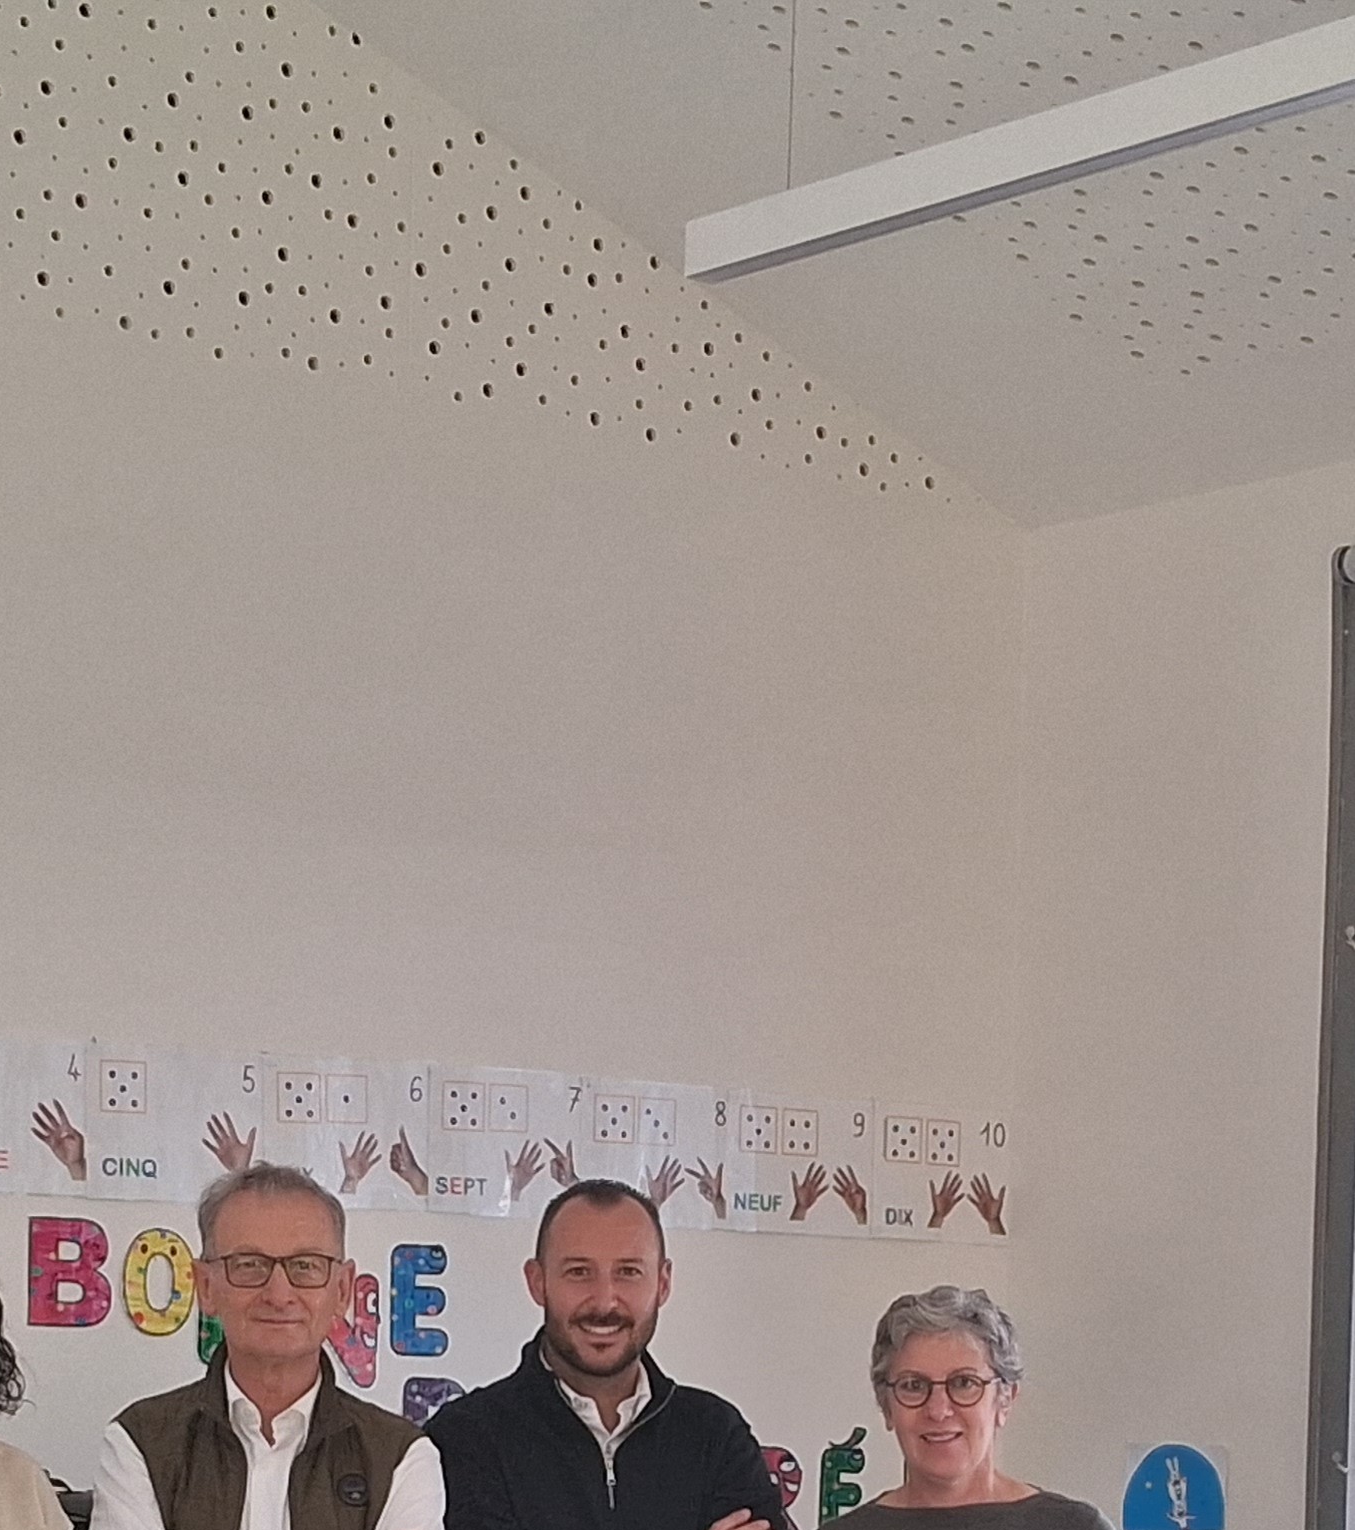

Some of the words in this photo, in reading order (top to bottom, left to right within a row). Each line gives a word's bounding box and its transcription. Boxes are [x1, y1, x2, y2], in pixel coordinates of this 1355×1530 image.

[67, 1053, 82, 1082] 4
[242, 1065, 256, 1093] 5
[410, 1075, 423, 1102] 6
[568, 1086, 583, 1113] 7
[715, 1100, 727, 1126] 8
[853, 1112, 866, 1138] 9
[979, 1121, 1007, 1148] 10
[102, 1157, 158, 1179] CINQ
[435, 1176, 488, 1196] SEPT
[734, 1192, 783, 1212] NEUF
[885, 1206, 914, 1227] DIX
